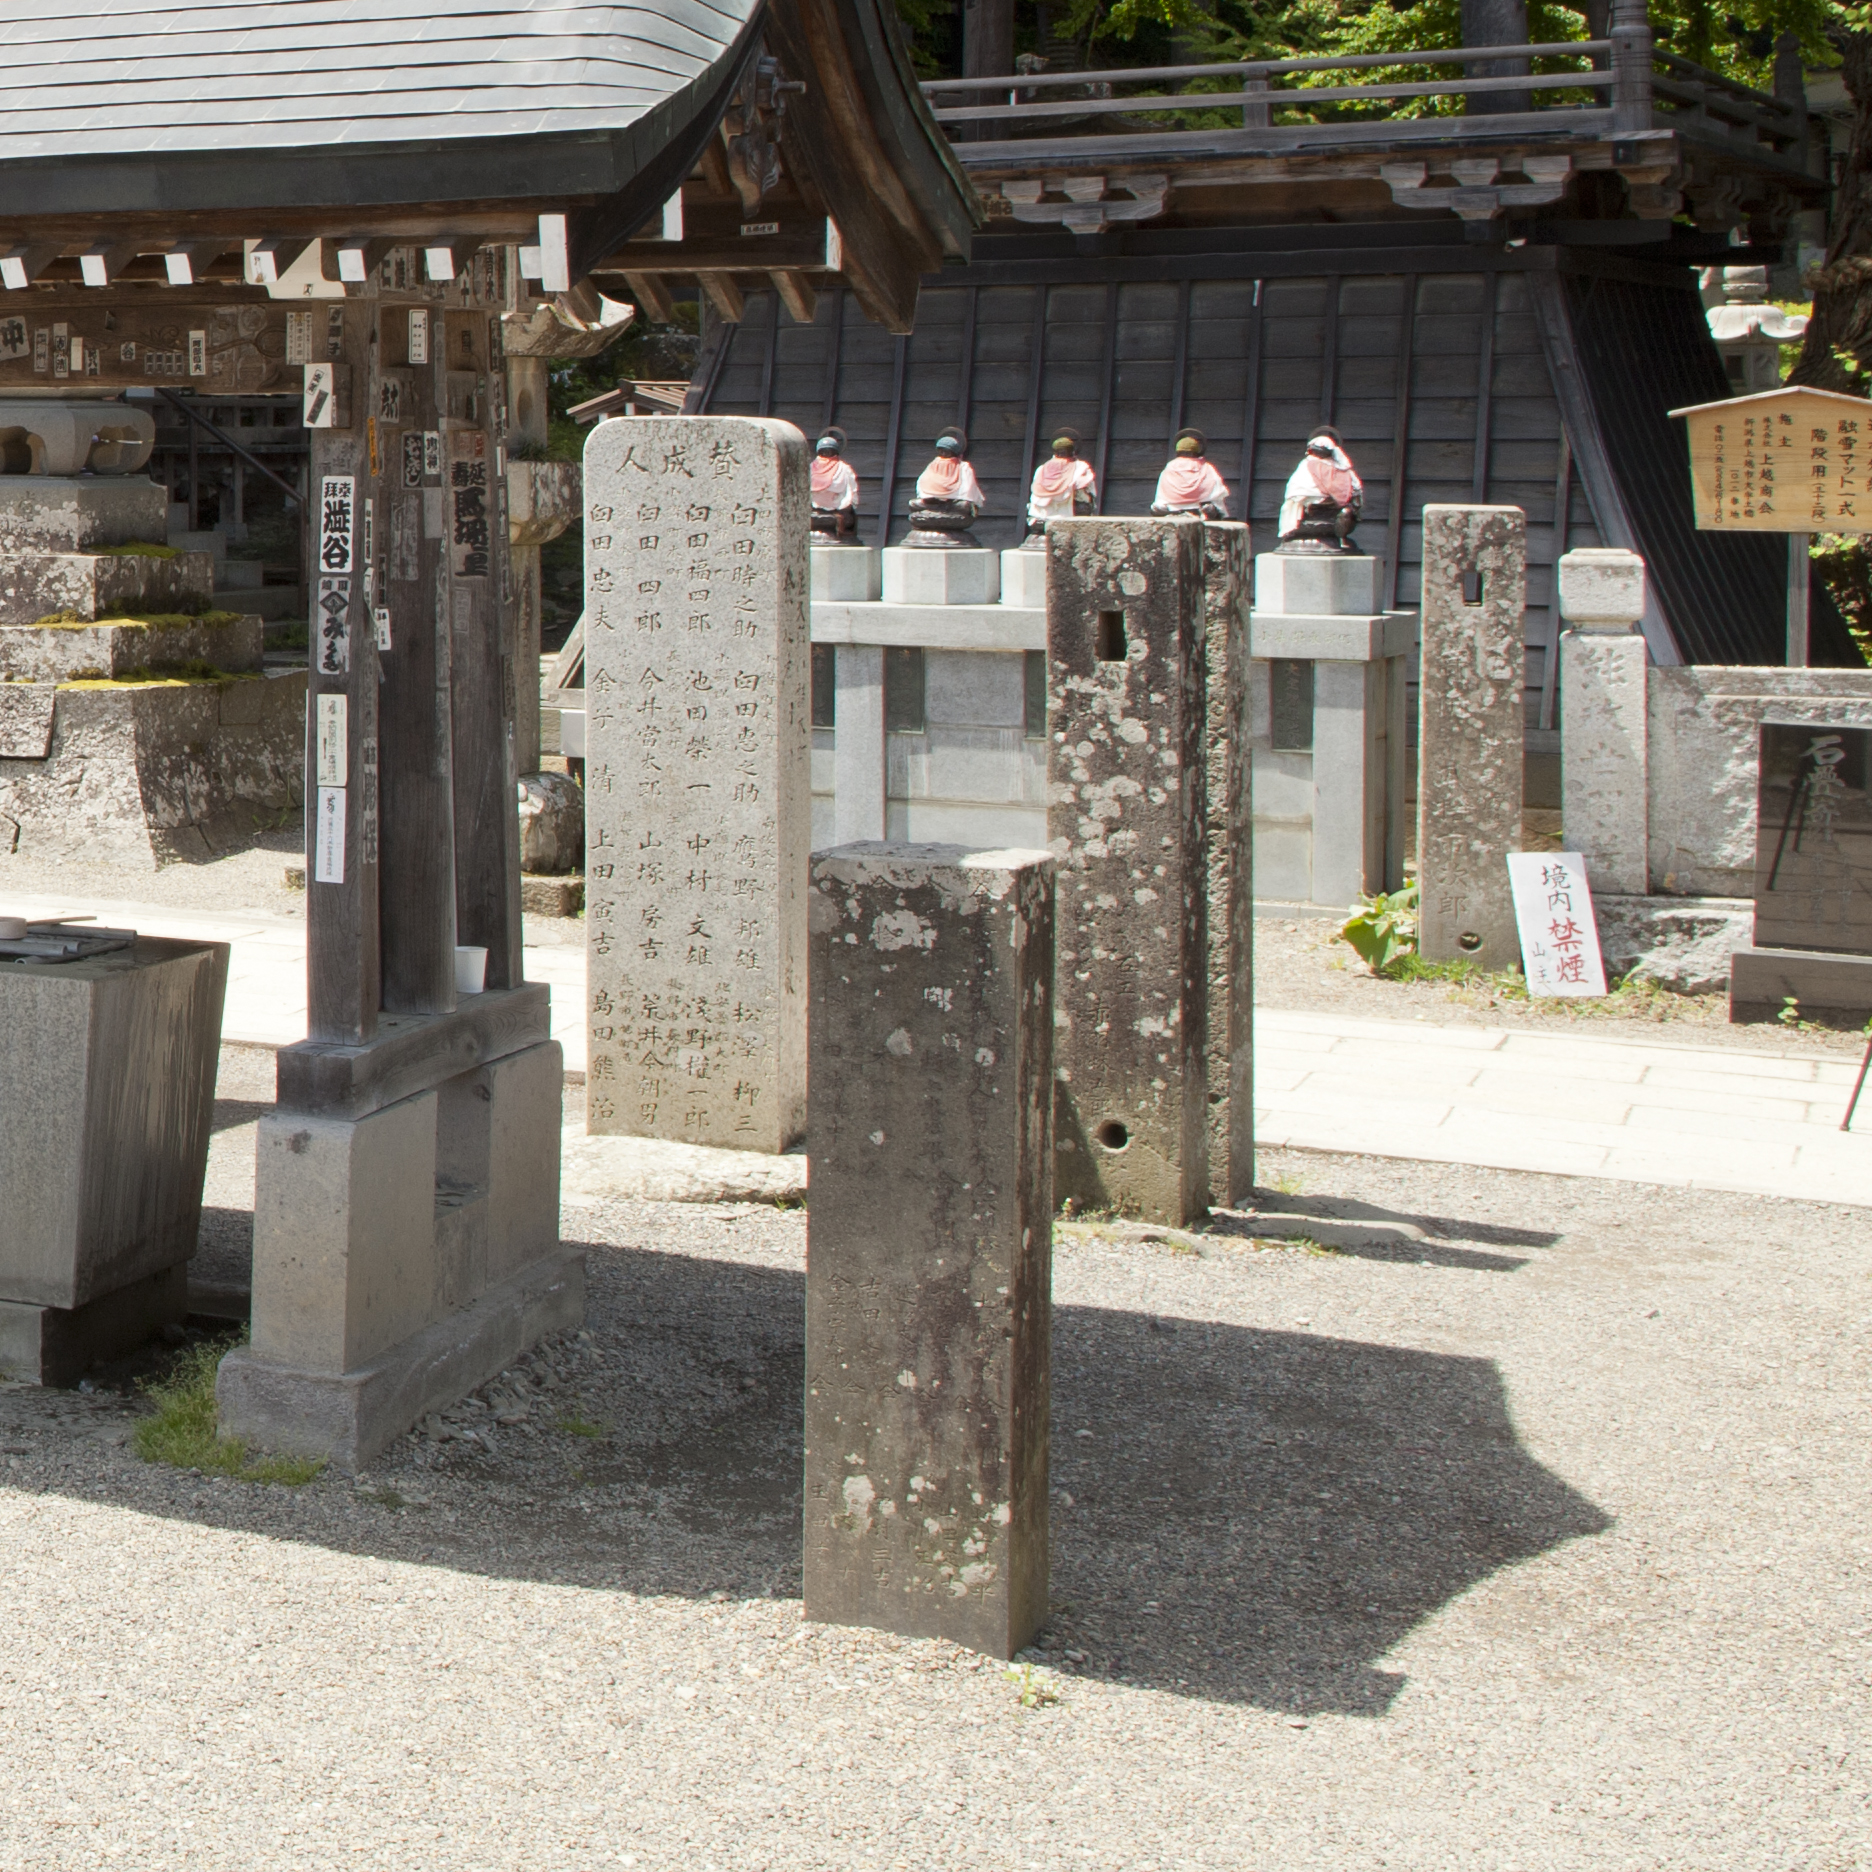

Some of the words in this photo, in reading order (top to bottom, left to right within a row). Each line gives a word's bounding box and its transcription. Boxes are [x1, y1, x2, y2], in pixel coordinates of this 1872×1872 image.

[1758, 452, 1776, 517] 上越商会
[1836, 419, 1859, 518] 融雪マット一式
[590, 503, 616, 632] 臼田忠夫
[684, 503, 712, 634] 臼田福四郎
[686, 832, 714, 966] 中村文雄
[1540, 863, 1590, 984] 境内禁煙
